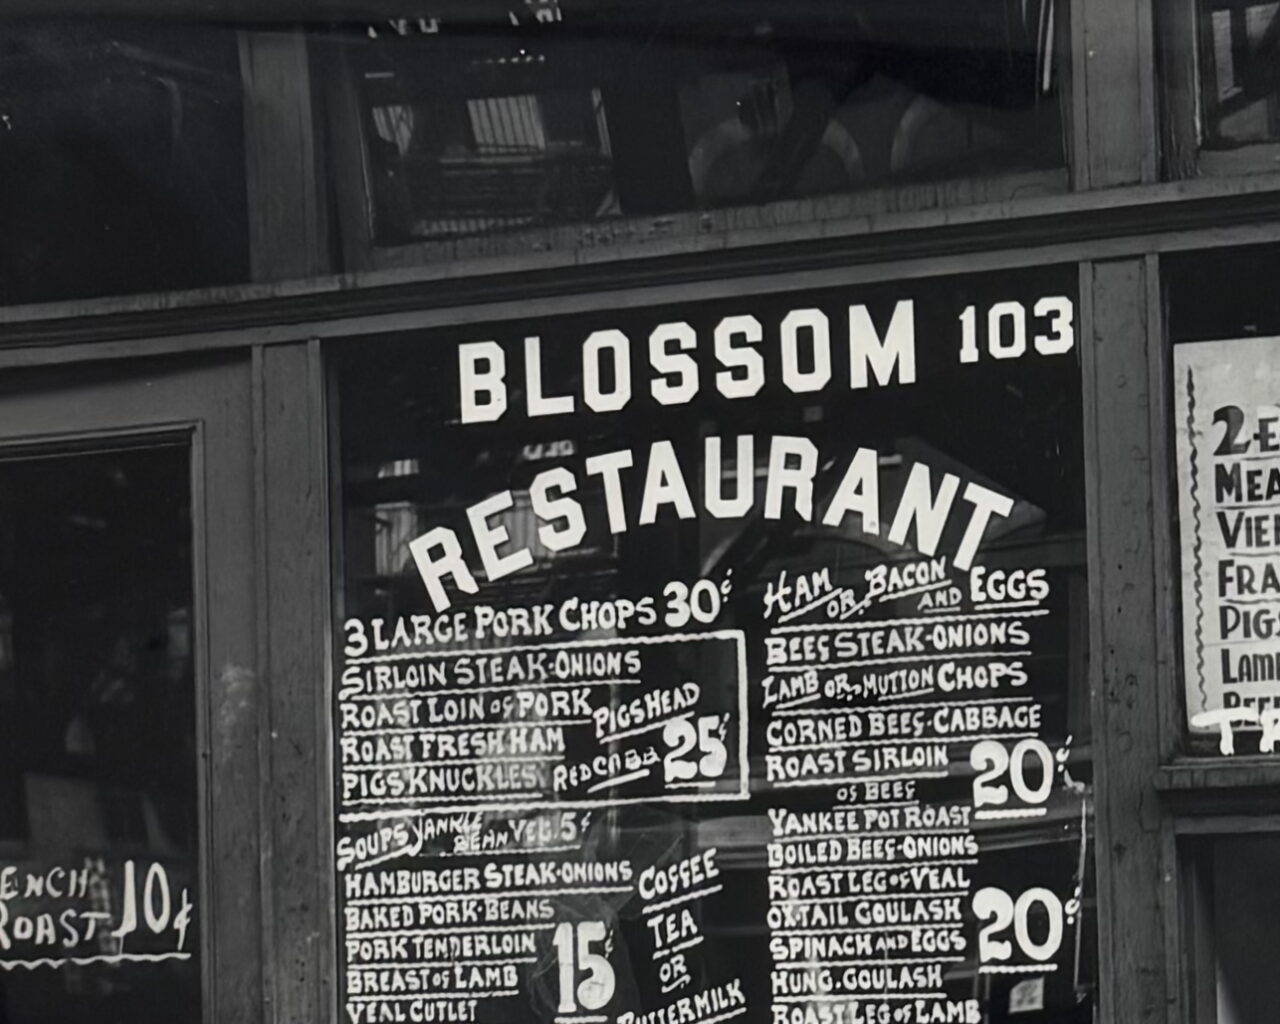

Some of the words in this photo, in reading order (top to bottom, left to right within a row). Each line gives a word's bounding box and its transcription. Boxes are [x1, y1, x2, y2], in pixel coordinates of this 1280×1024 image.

[459, 299, 916, 424] BLOSSOM
[959, 296, 1074, 364] 103
[1212, 404, 1250, 457] 2
[409, 434, 1014, 613] RESTAURANT
[763, 568, 833, 619] HAM
[865, 556, 948, 598] BACON
[917, 587, 963, 609] AND
[970, 566, 1049, 602] EGGS
[344, 618, 367, 656] 3
[372, 611, 467, 650] LARGE
[475, 599, 554, 638] PORK
[559, 597, 657, 630] CHOPS
[339, 661, 447, 700] SIRLOIN
[762, 669, 820, 709] LAMB
[863, 666, 934, 697] MUTTON
[937, 662, 1028, 692] CHOPS
[340, 698, 420, 729] ROAST
[429, 697, 484, 722] LOIN
[518, 689, 594, 718] PORK
[341, 735, 415, 763] ROAST
[420, 731, 500, 759] FRESH
[509, 726, 566, 753] HAM
[766, 715, 862, 747] CORNED
[766, 749, 848, 781] ROAST
[852, 745, 948, 771] SIRLOIN
[342, 769, 404, 797] PIGS
[409, 764, 538, 793] KNUCKLES
[768, 809, 859, 836] YANKEE
[865, 810, 899, 830] POT
[904, 806, 971, 828] ROAST
[767, 841, 842, 868] BOILED
[345, 867, 481, 899] HAMBURGER
[768, 874, 843, 899] ROAST
[850, 871, 886, 893] LEG
[911, 867, 970, 890] VEAL
[345, 903, 414, 931] BAKED
[855, 898, 962, 924] GOULASH
[648, 910, 697, 948] TEA
[769, 934, 872, 961] SPINACH
[876, 934, 908, 951] AND
[911, 929, 966, 953] EGGS
[345, 937, 409, 962] PORK
[414, 933, 537, 959] TENDERLOIN
[347, 968, 430, 993] BREAST
[454, 965, 519, 989] LAMB
[843, 964, 942, 990] GOULASH
[345, 1002, 405, 1024] VEAL
[413, 1000, 478, 1022] CUTLET
[915, 999, 981, 1024] LAMB
